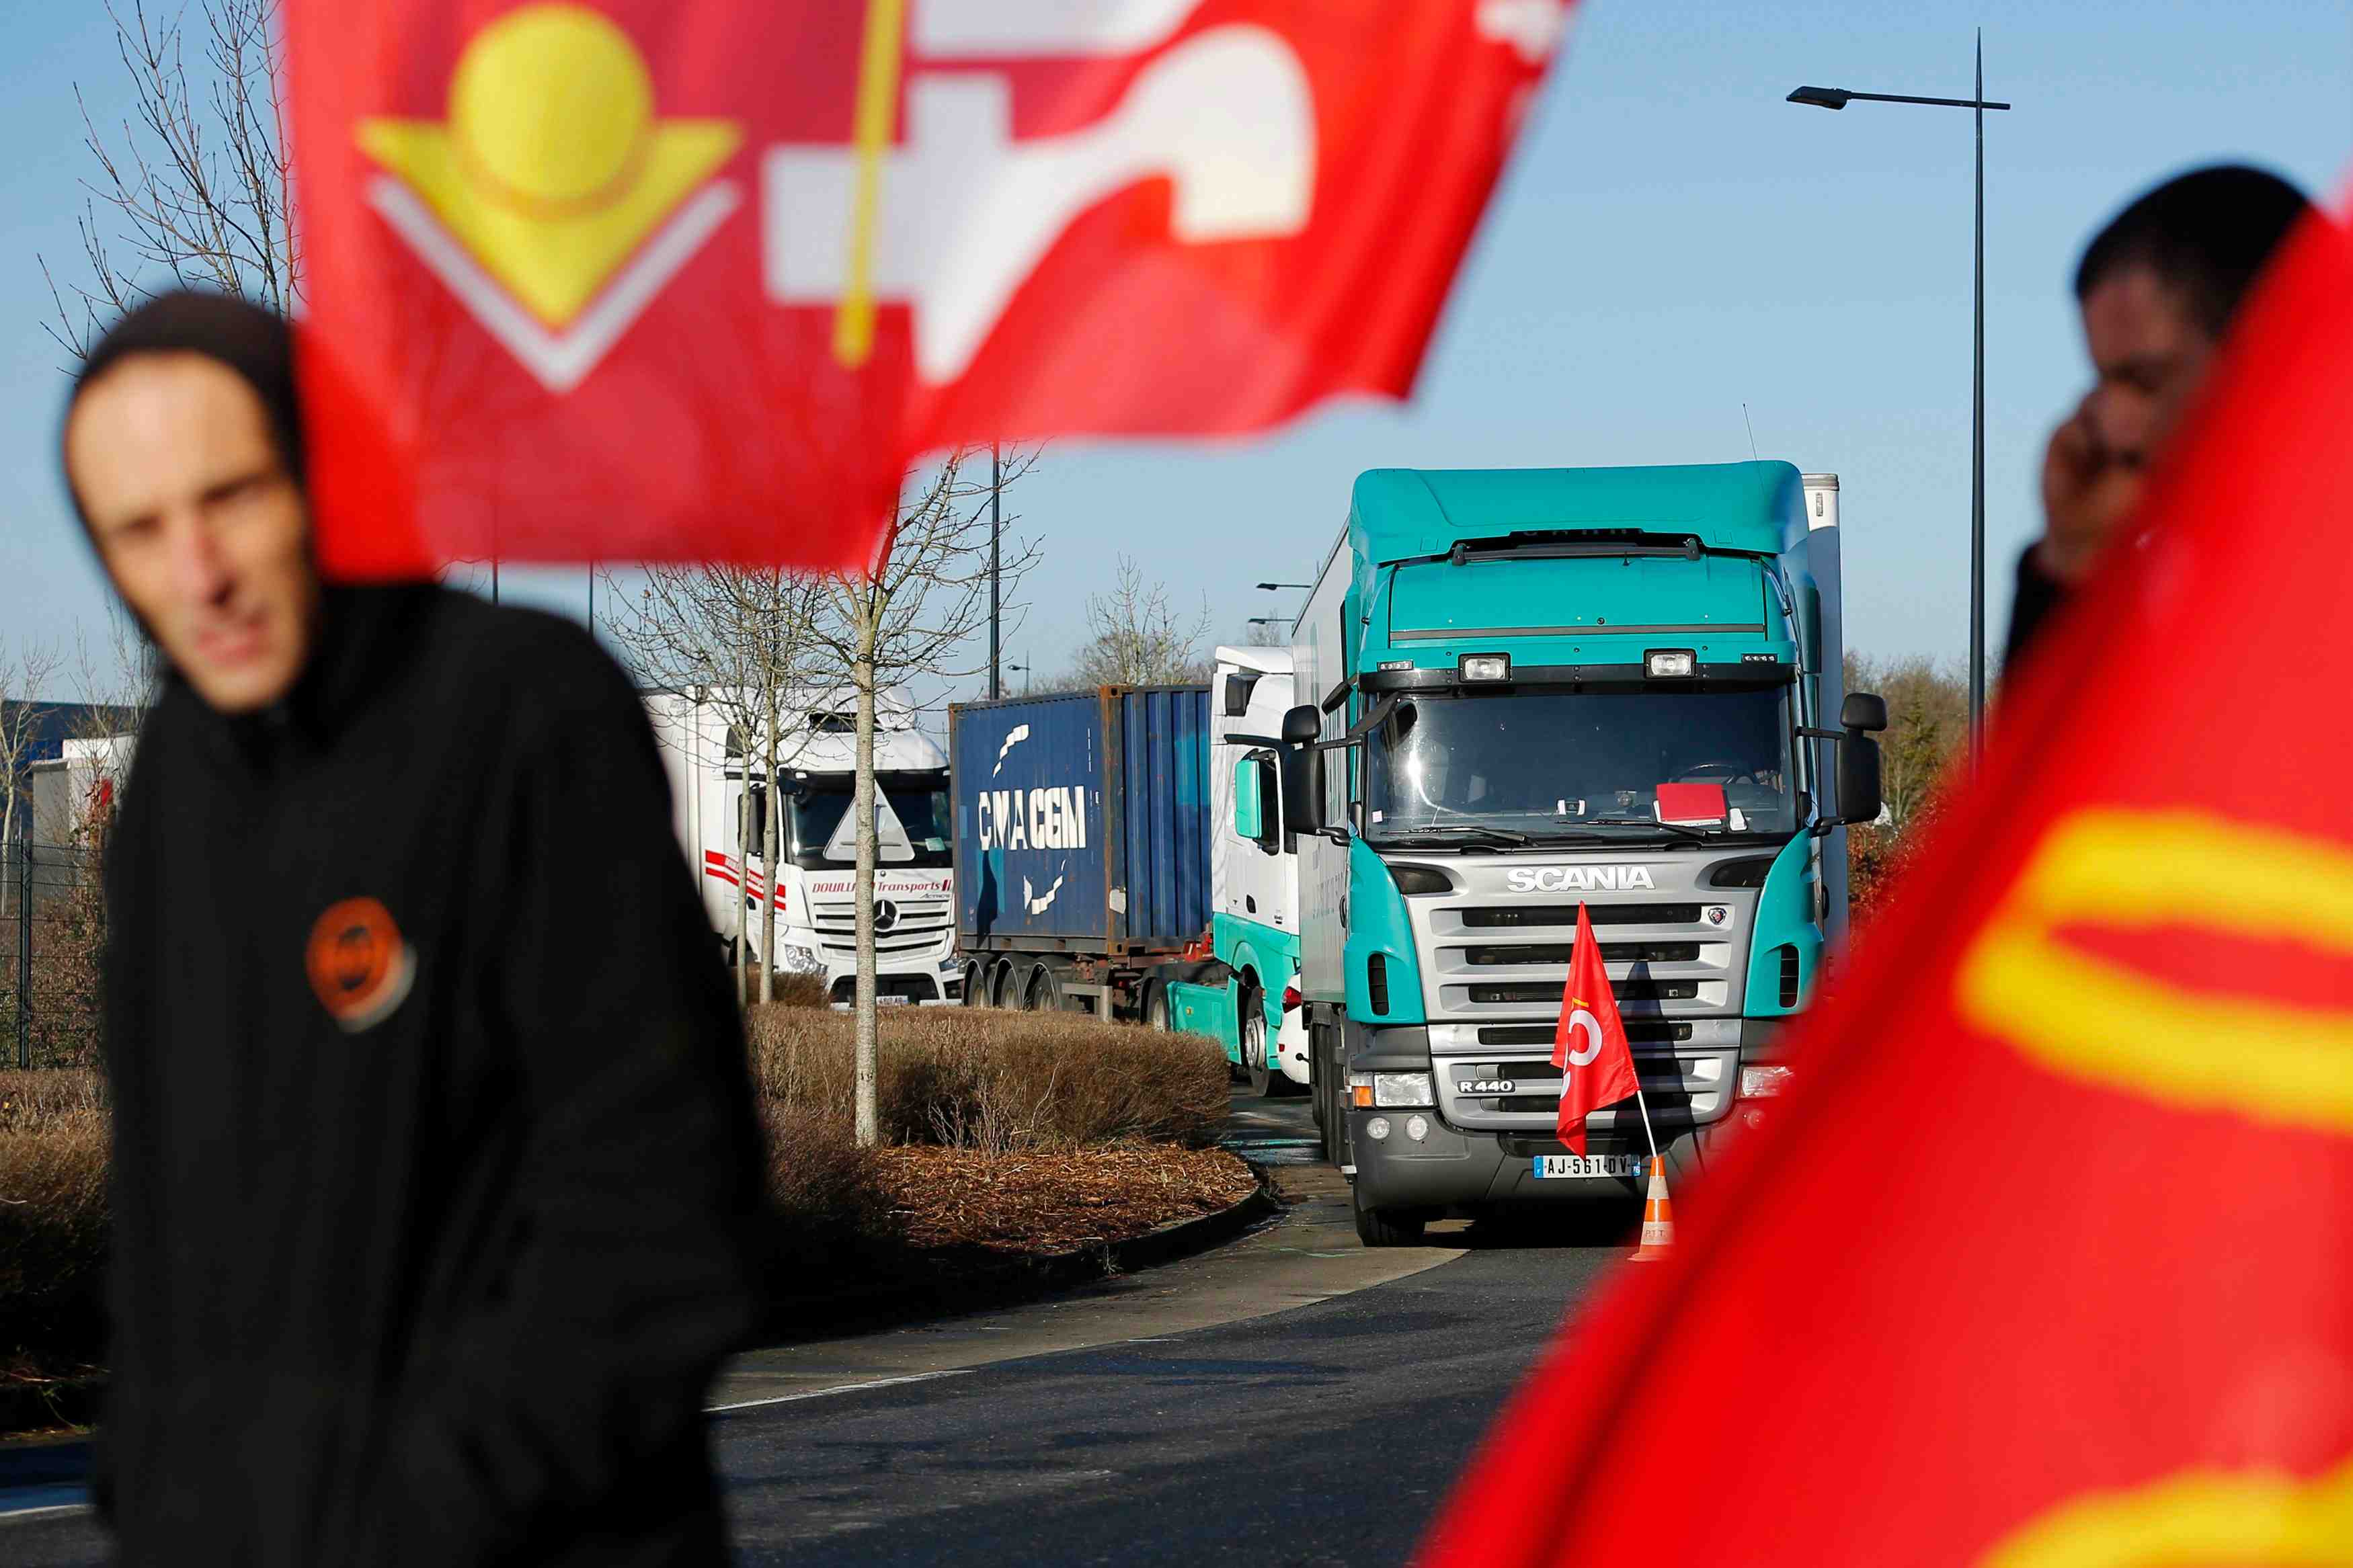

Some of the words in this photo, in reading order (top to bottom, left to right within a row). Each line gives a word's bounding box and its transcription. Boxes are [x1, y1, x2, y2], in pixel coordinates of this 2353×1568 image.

[979, 789, 1029, 851] CMA
[1029, 786, 1086, 850] CGM
[878, 882, 940, 893] Transports
[1507, 866, 1656, 893] SCANIA
[1460, 1081, 1473, 1092] R
[1475, 1081, 1513, 1092] 440
[1548, 1158, 1627, 1174] AJ-561-DV
